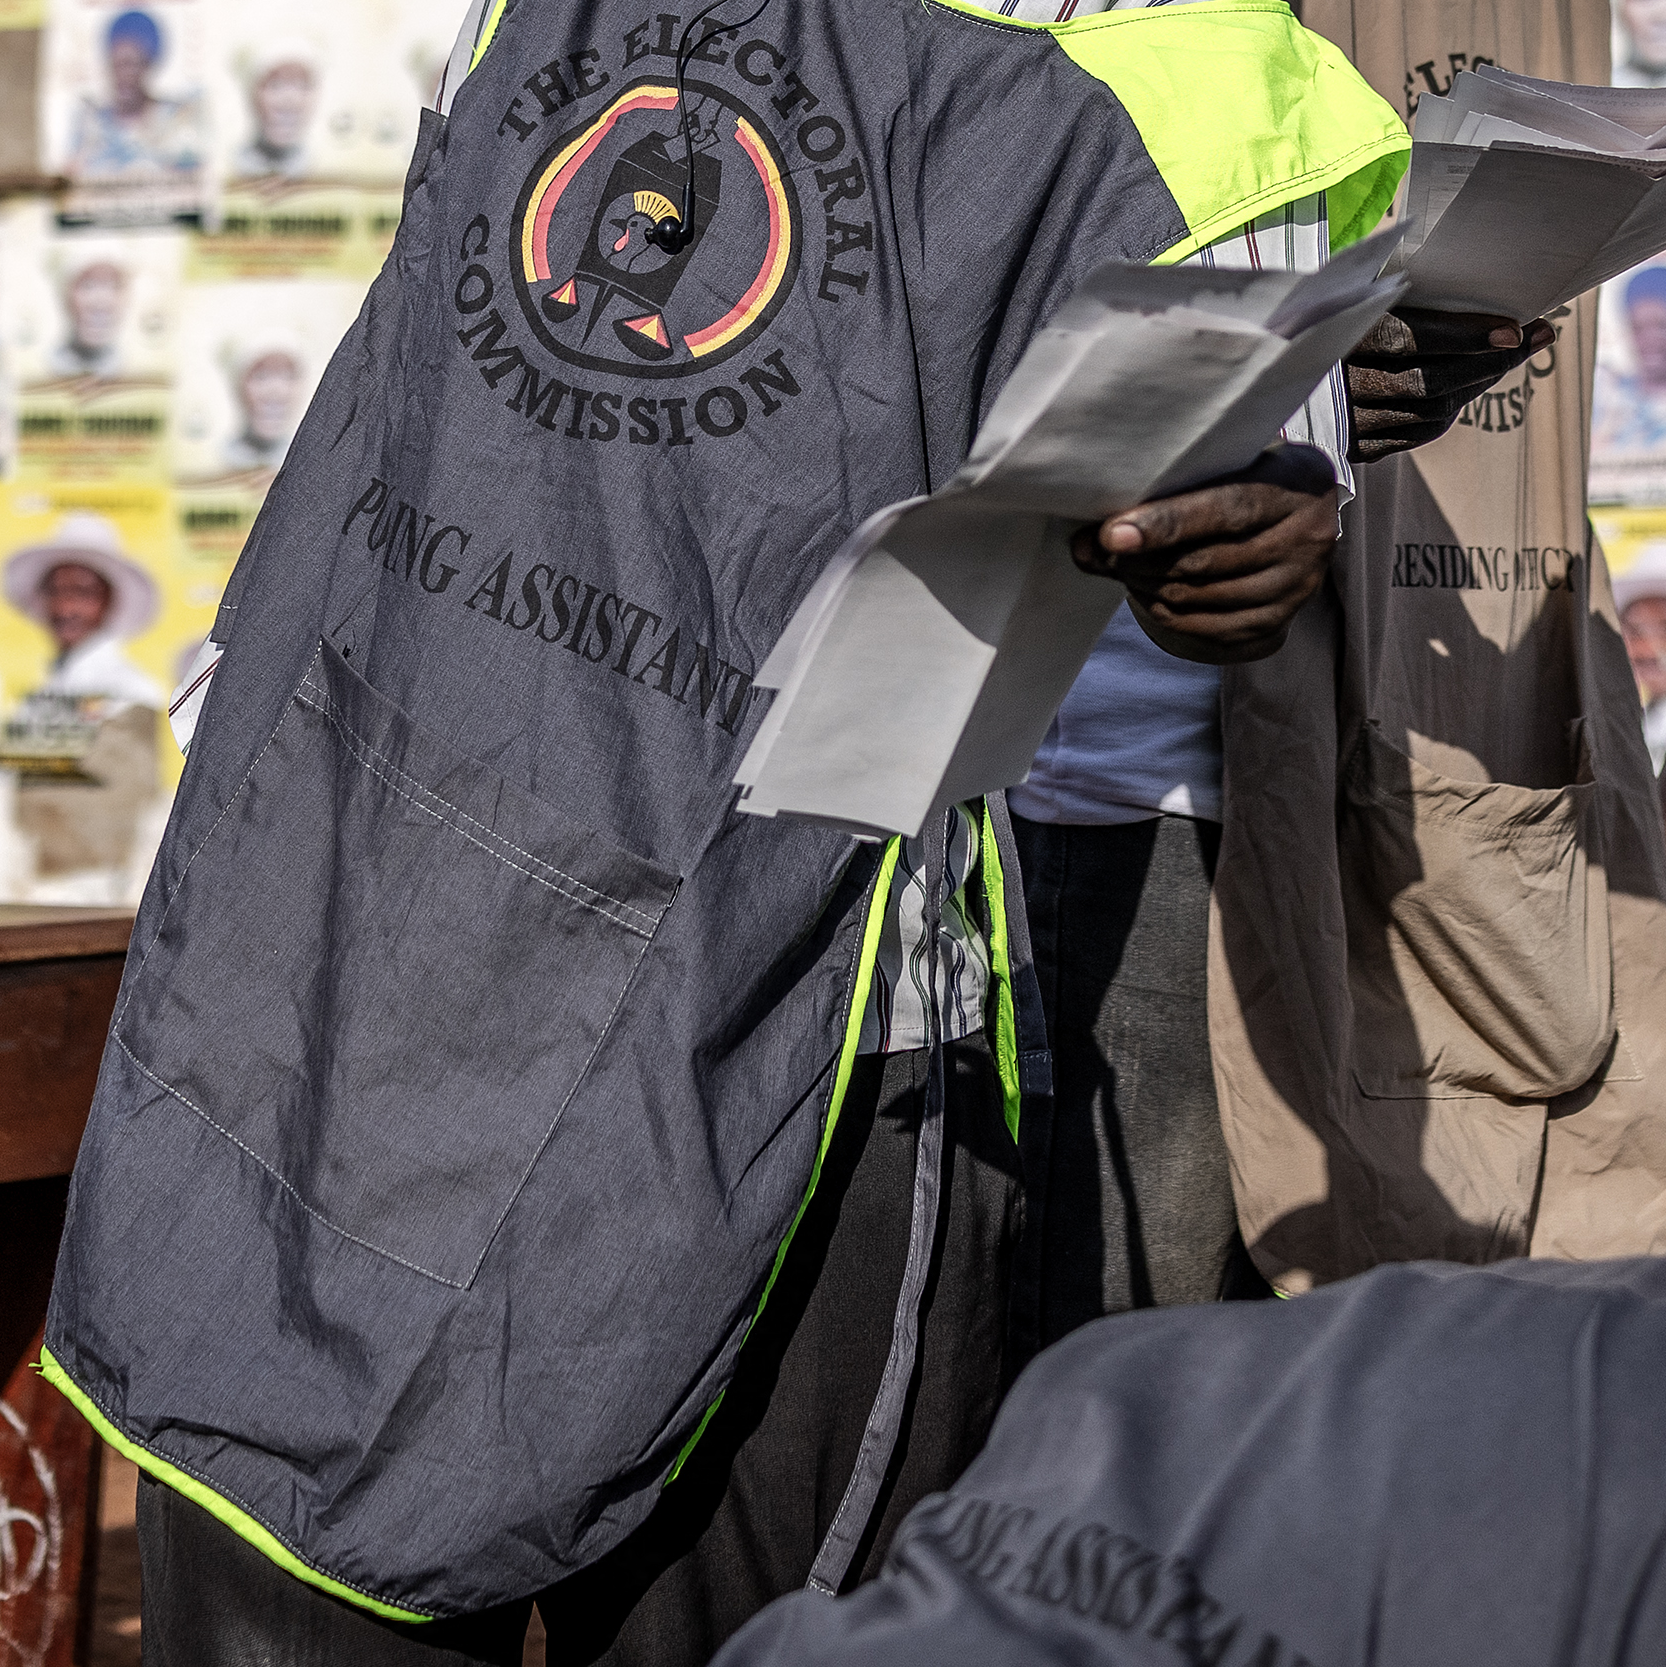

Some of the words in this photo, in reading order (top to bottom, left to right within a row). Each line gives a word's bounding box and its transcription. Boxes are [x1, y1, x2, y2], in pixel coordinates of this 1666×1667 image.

[497, 46, 612, 145] THE
[622, 13, 875, 305] ELECTORAL
[454, 213, 805, 448] COMMISSION
[464, 549, 759, 736] ASSISTANT
[1392, 543, 1510, 592] RESIDING
